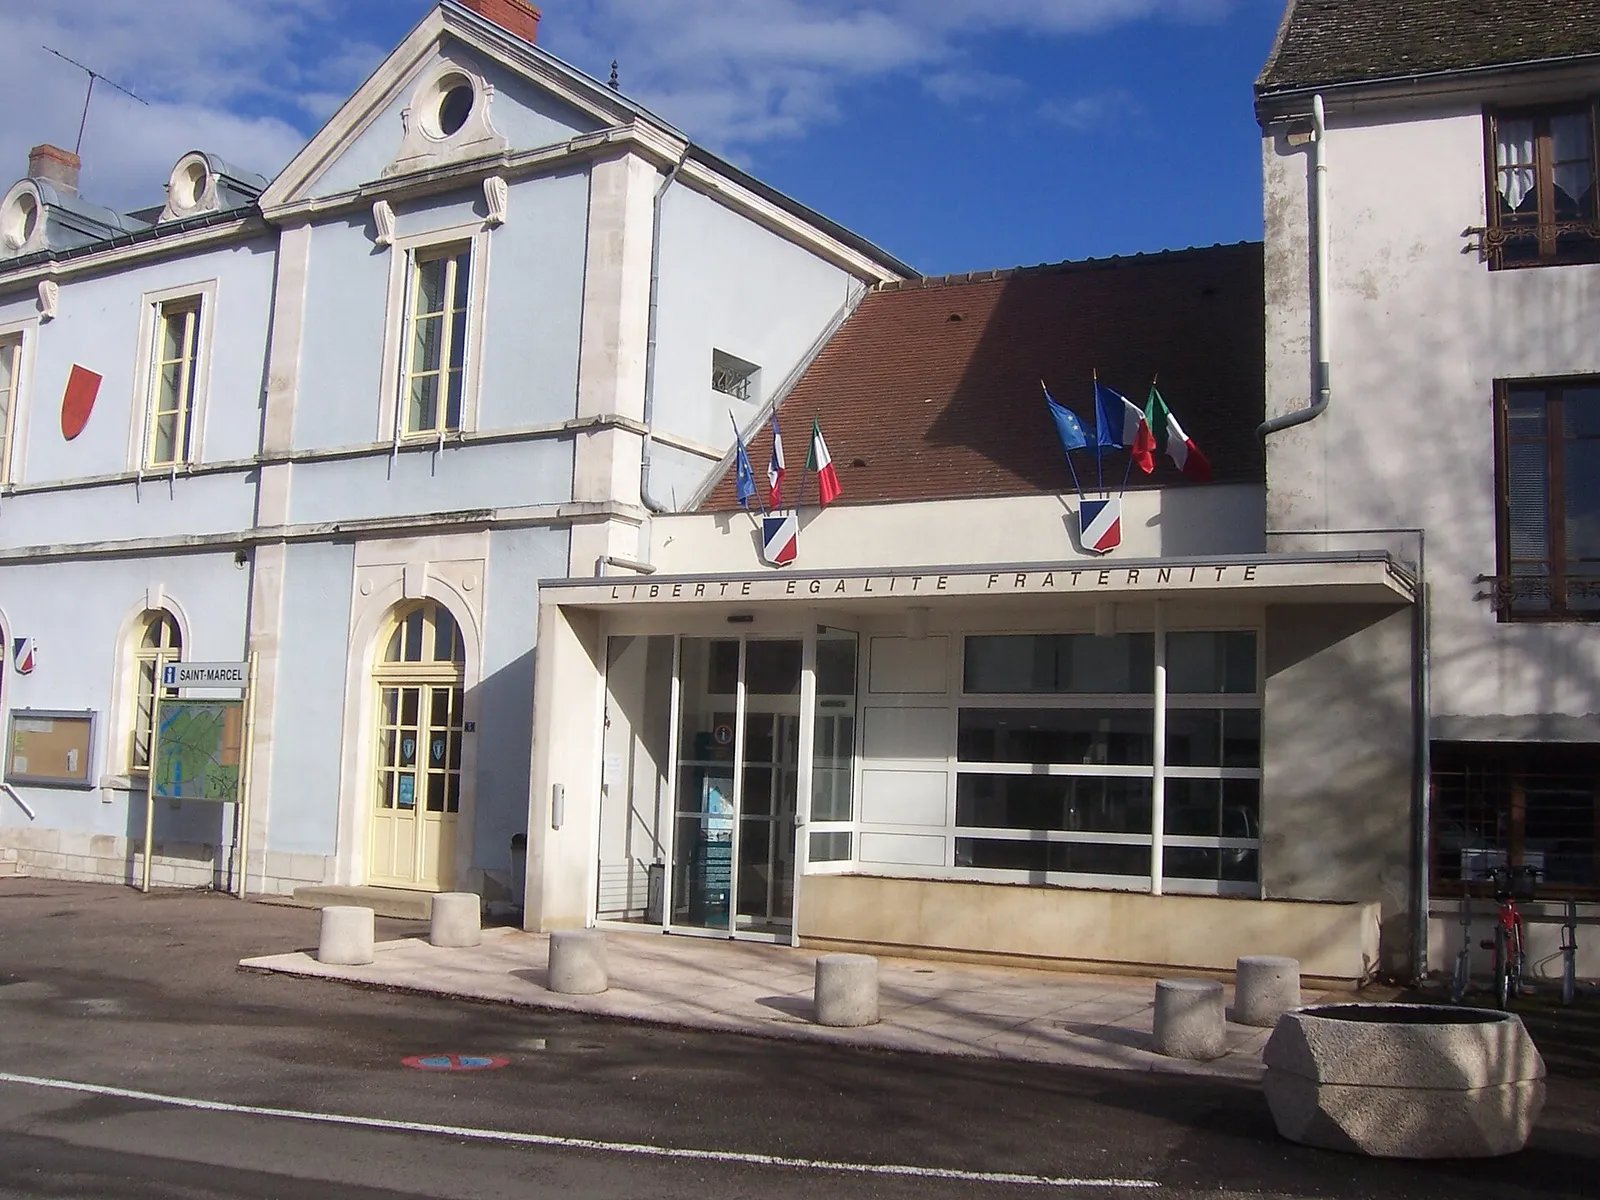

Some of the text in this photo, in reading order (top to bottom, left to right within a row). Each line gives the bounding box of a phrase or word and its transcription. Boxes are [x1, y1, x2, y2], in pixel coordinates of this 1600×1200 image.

[611, 566, 1257, 599] LIBERTE EGALITE FRATERNITE
[180, 669, 243, 681] SAINT-MARCEL
